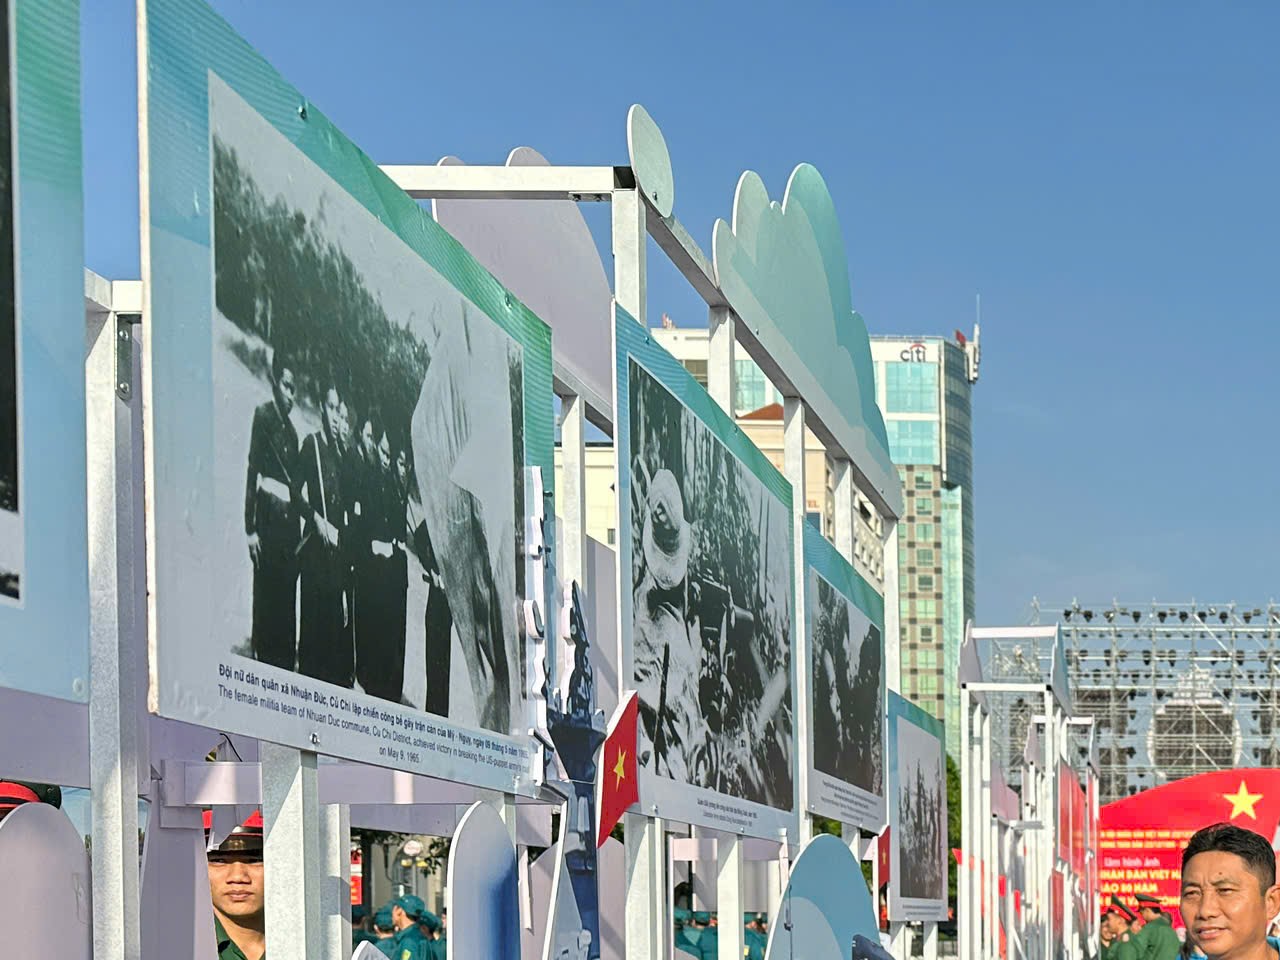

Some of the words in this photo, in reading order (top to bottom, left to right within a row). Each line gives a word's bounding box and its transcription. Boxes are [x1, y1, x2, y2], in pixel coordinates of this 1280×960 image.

[900, 345, 926, 362] citi
[218, 663, 232, 680] Đội
[340, 698, 351, 712] Chi
[218, 683, 232, 700] The
[234, 688, 258, 706] female
[260, 697, 280, 712] militia
[280, 702, 297, 716] team
[298, 706, 306, 718] of
[306, 708, 326, 724] Nhuan
[328, 714, 340, 727] Duc
[341, 720, 372, 736] commune,
[372, 725, 380, 738] Cu
[382, 728, 391, 740] Chi
[412, 738, 436, 751] achieved
[436, 744, 452, 758] victory
[452, 748, 458, 756] in
[458, 750, 478, 764] breaking
[379, 746, 386, 757] on
[387, 746, 399, 762] May
